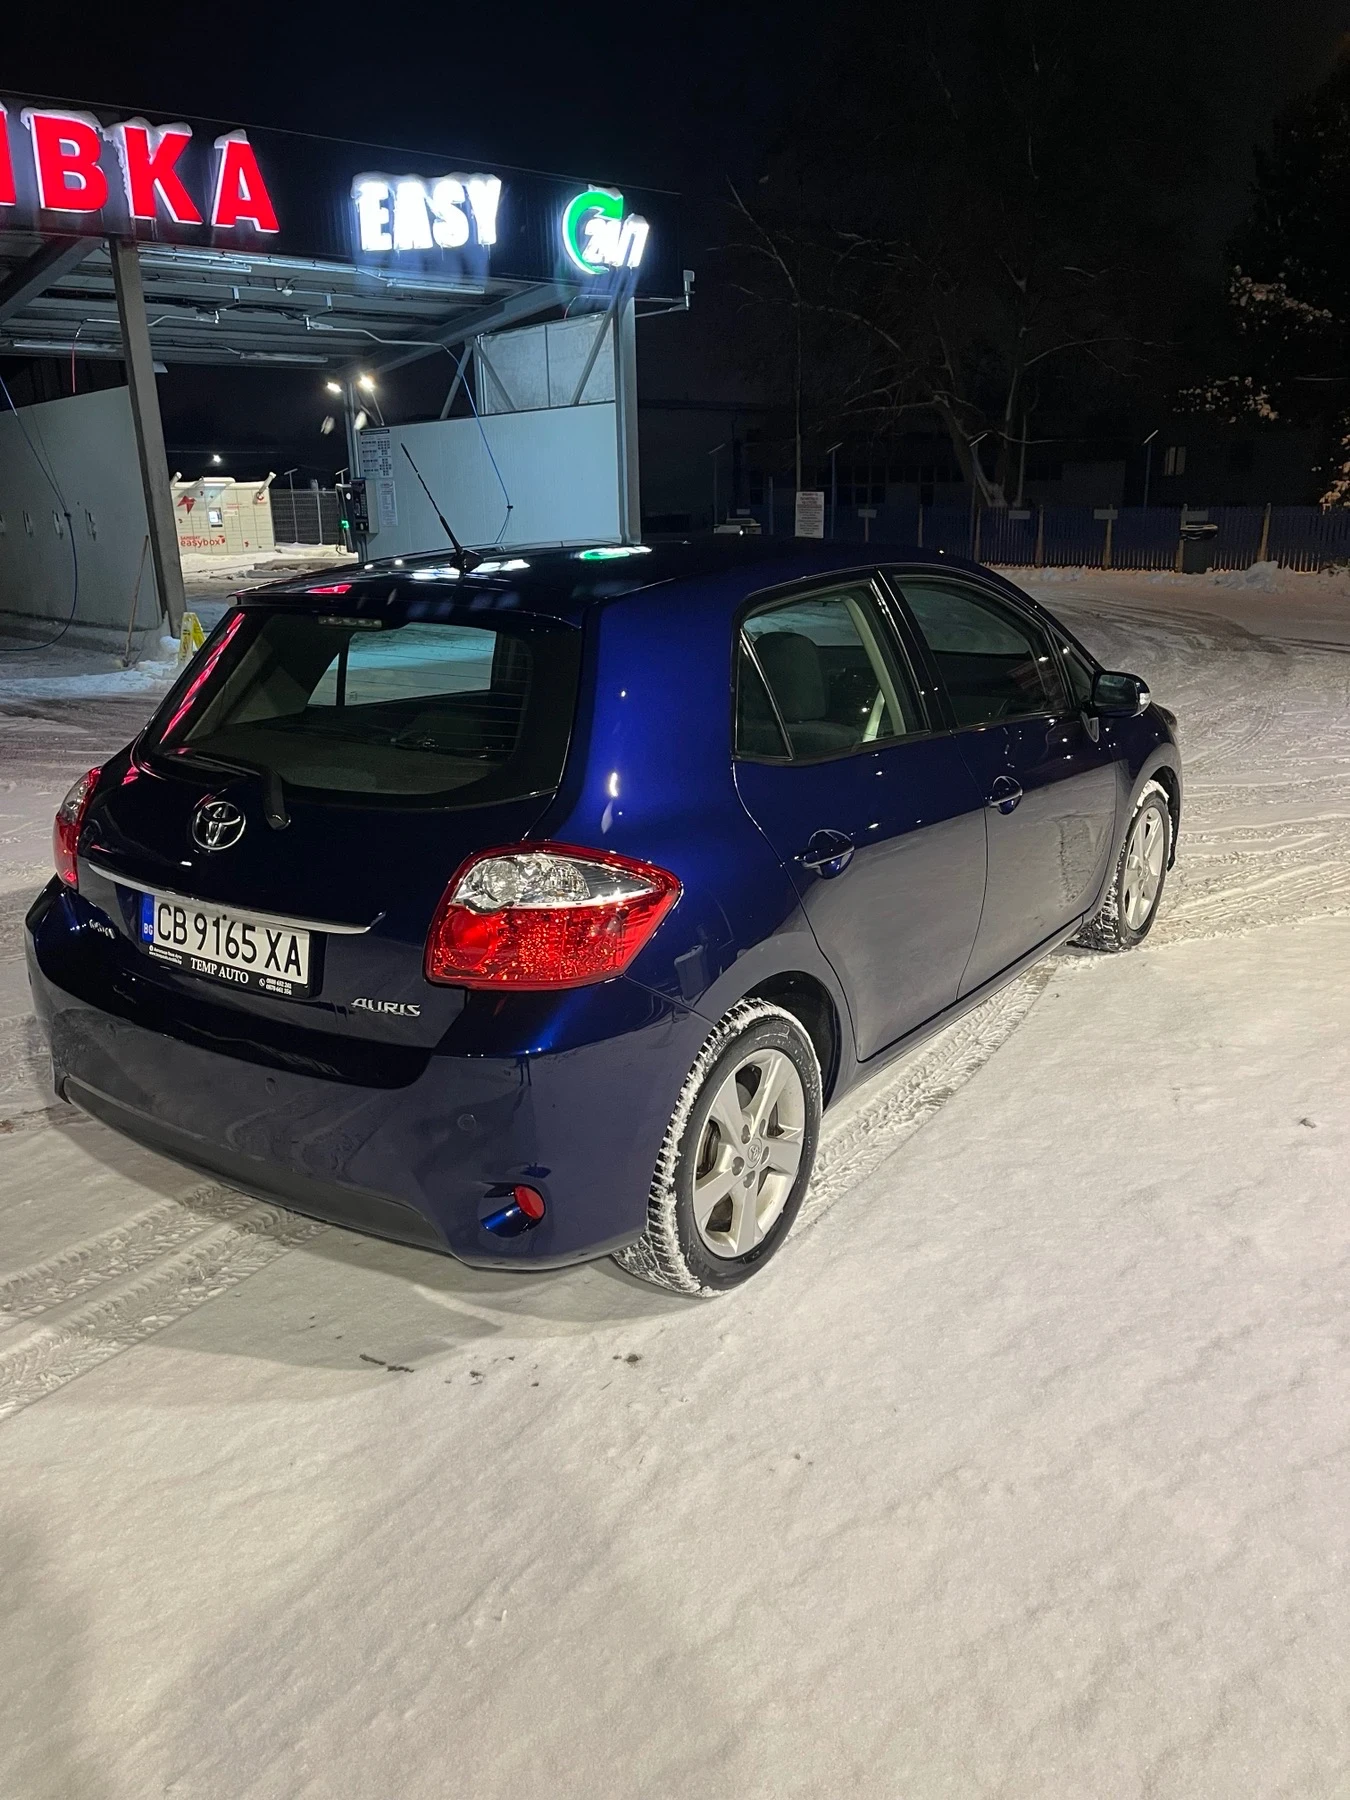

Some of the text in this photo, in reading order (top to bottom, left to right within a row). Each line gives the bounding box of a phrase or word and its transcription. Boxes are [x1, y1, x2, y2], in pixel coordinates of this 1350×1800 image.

[359, 179, 501, 251] EASY
[180, 538, 220, 548] easybox
[143, 923, 153, 935] BG
[194, 912, 257, 964] 9165
[190, 957, 217, 975] TEMP
[218, 966, 249, 984] AUTO
[351, 998, 421, 1016] AURIS
